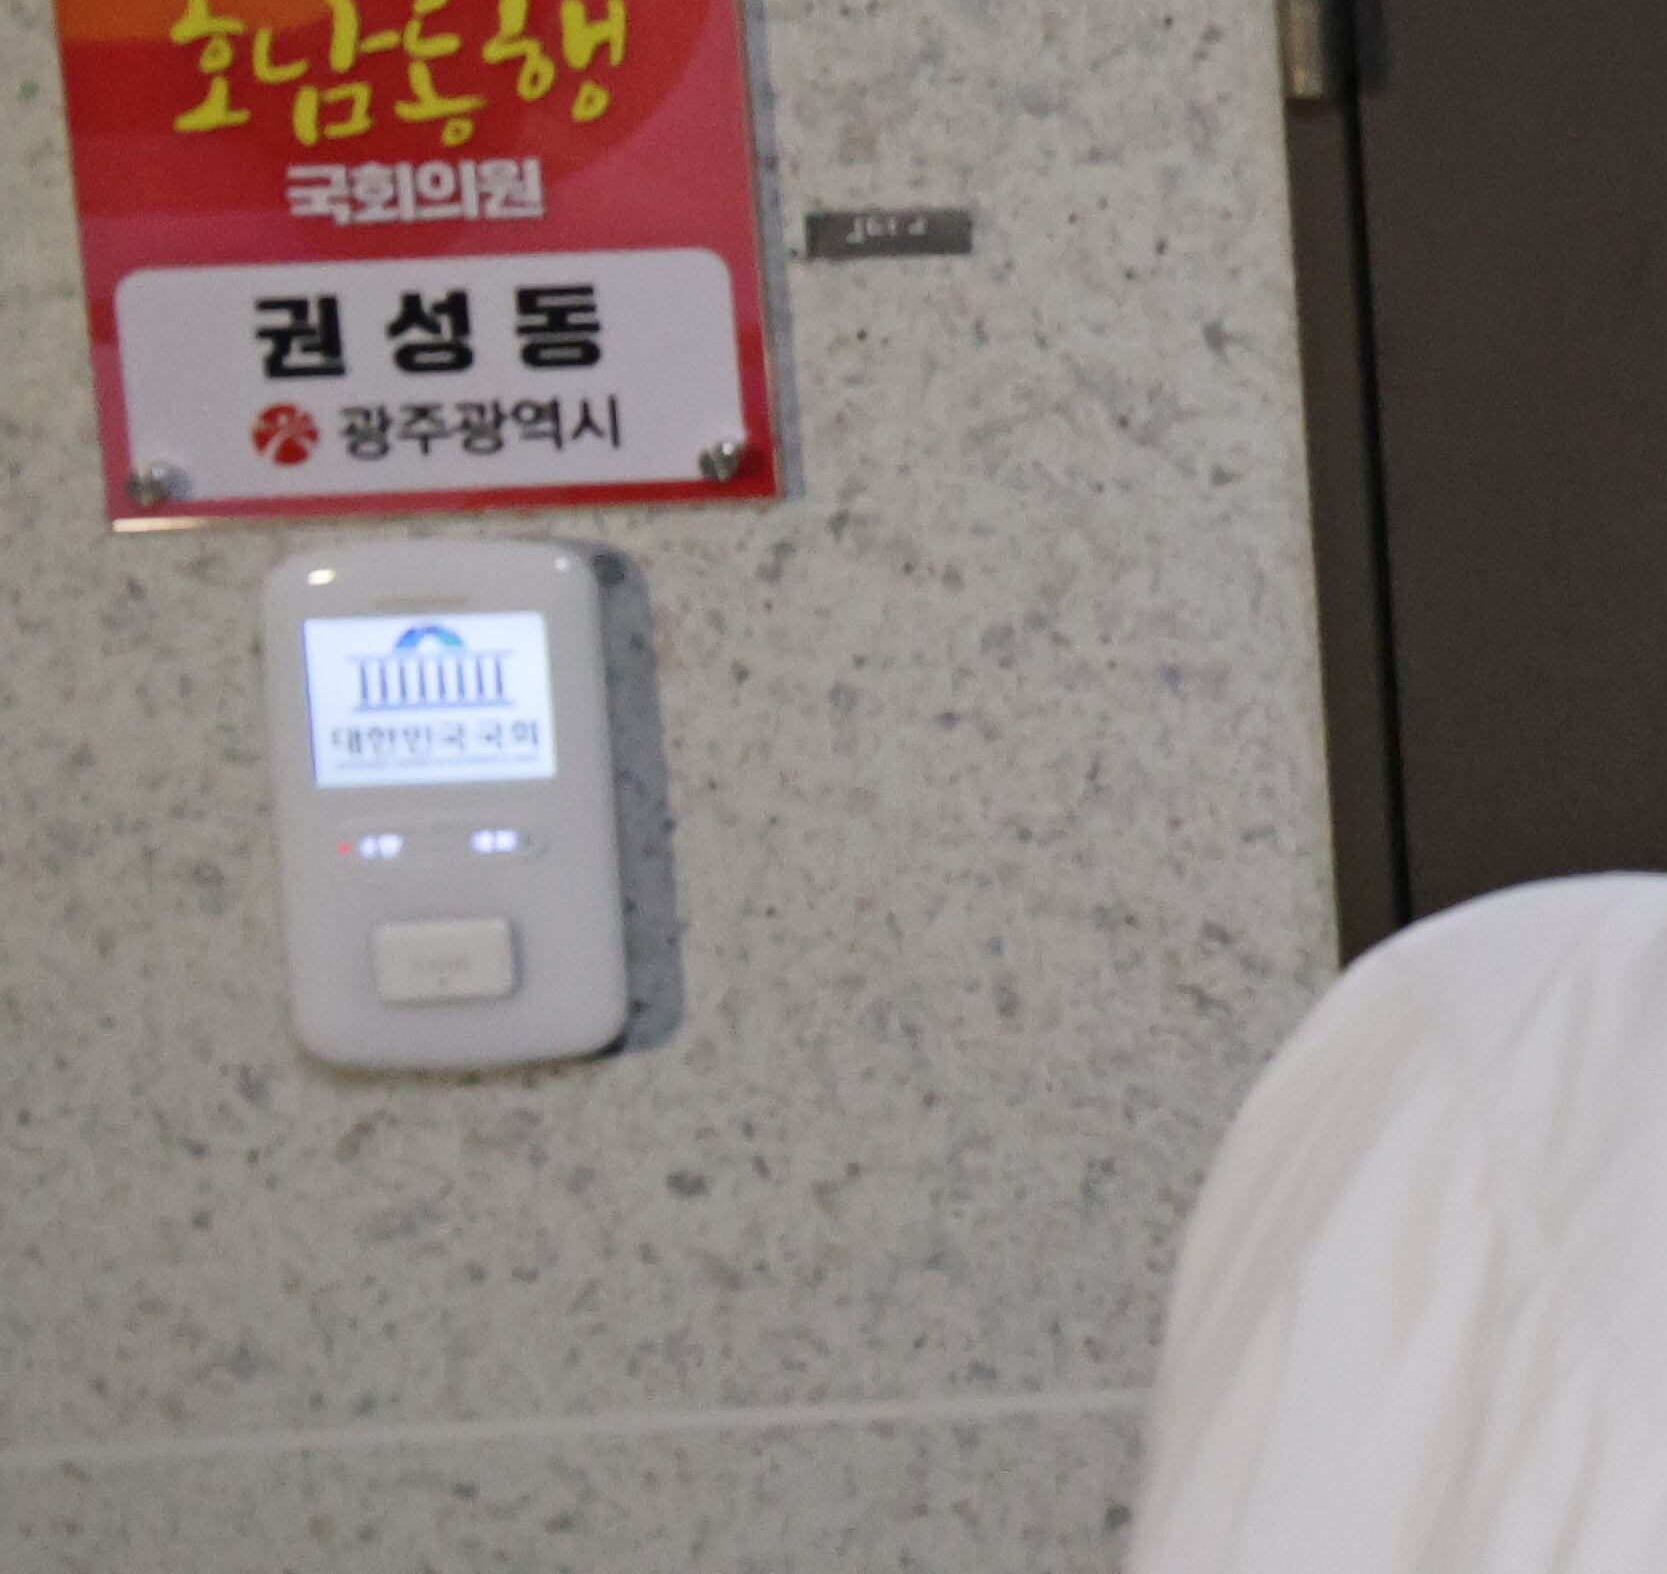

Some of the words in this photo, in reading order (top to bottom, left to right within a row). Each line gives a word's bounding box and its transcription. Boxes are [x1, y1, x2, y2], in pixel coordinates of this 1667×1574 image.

[286, 158, 544, 226] 국회의원
[254, 285, 604, 379] 권성동
[338, 395, 622, 460] 광주광역시
